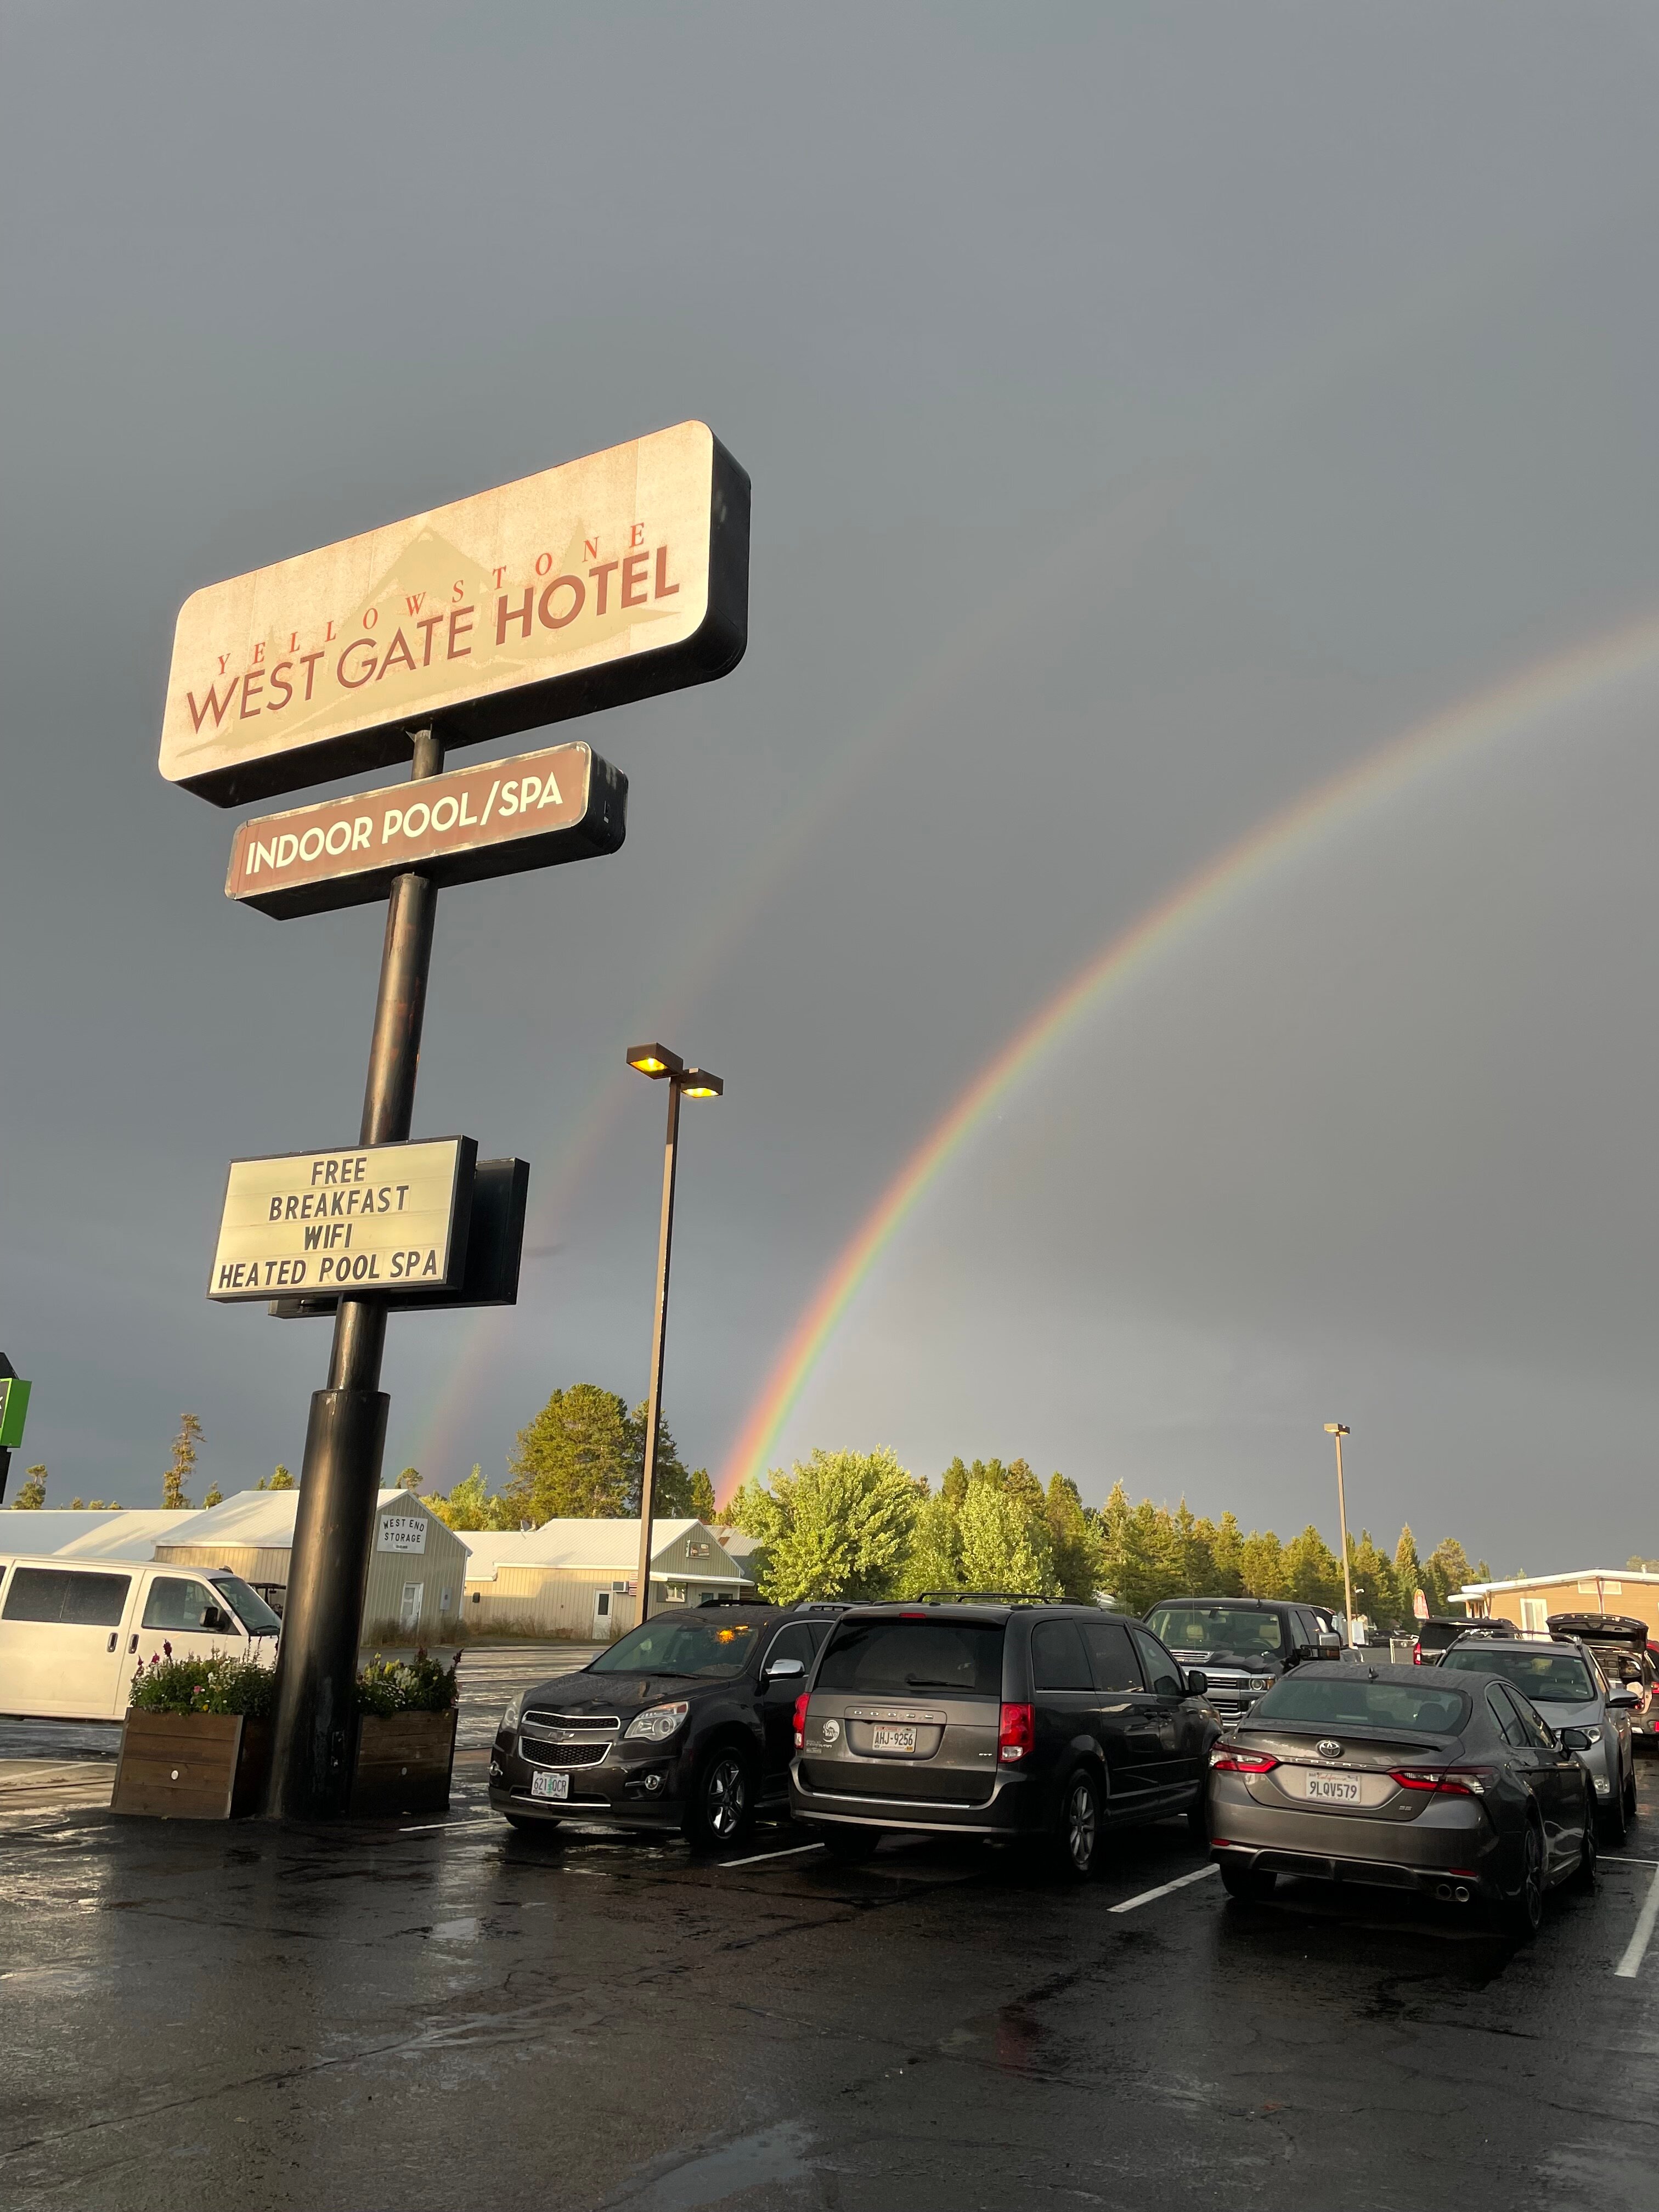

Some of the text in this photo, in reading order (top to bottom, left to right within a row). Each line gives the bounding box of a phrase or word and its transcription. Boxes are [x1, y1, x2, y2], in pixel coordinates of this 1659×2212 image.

[218, 522, 645, 676] YELLOWSTONE
[187, 545, 681, 735] WEST GATE HOTEL
[245, 771, 563, 875] INDOOR POOL/SPA
[311, 1156, 367, 1186] FREE
[269, 1184, 409, 1221] BREAKFAST
[304, 1223, 353, 1251] WIFI
[218, 1249, 437, 1289] HEATED POOL SPA
[383, 1519, 425, 1532] WEST END
[384, 1532, 421, 1543] STORAGE
[874, 1731, 913, 1746] AHJ-9256
[534, 1778, 567, 1792] 621 QCR
[1310, 1781, 1357, 1799] 9LQV579
